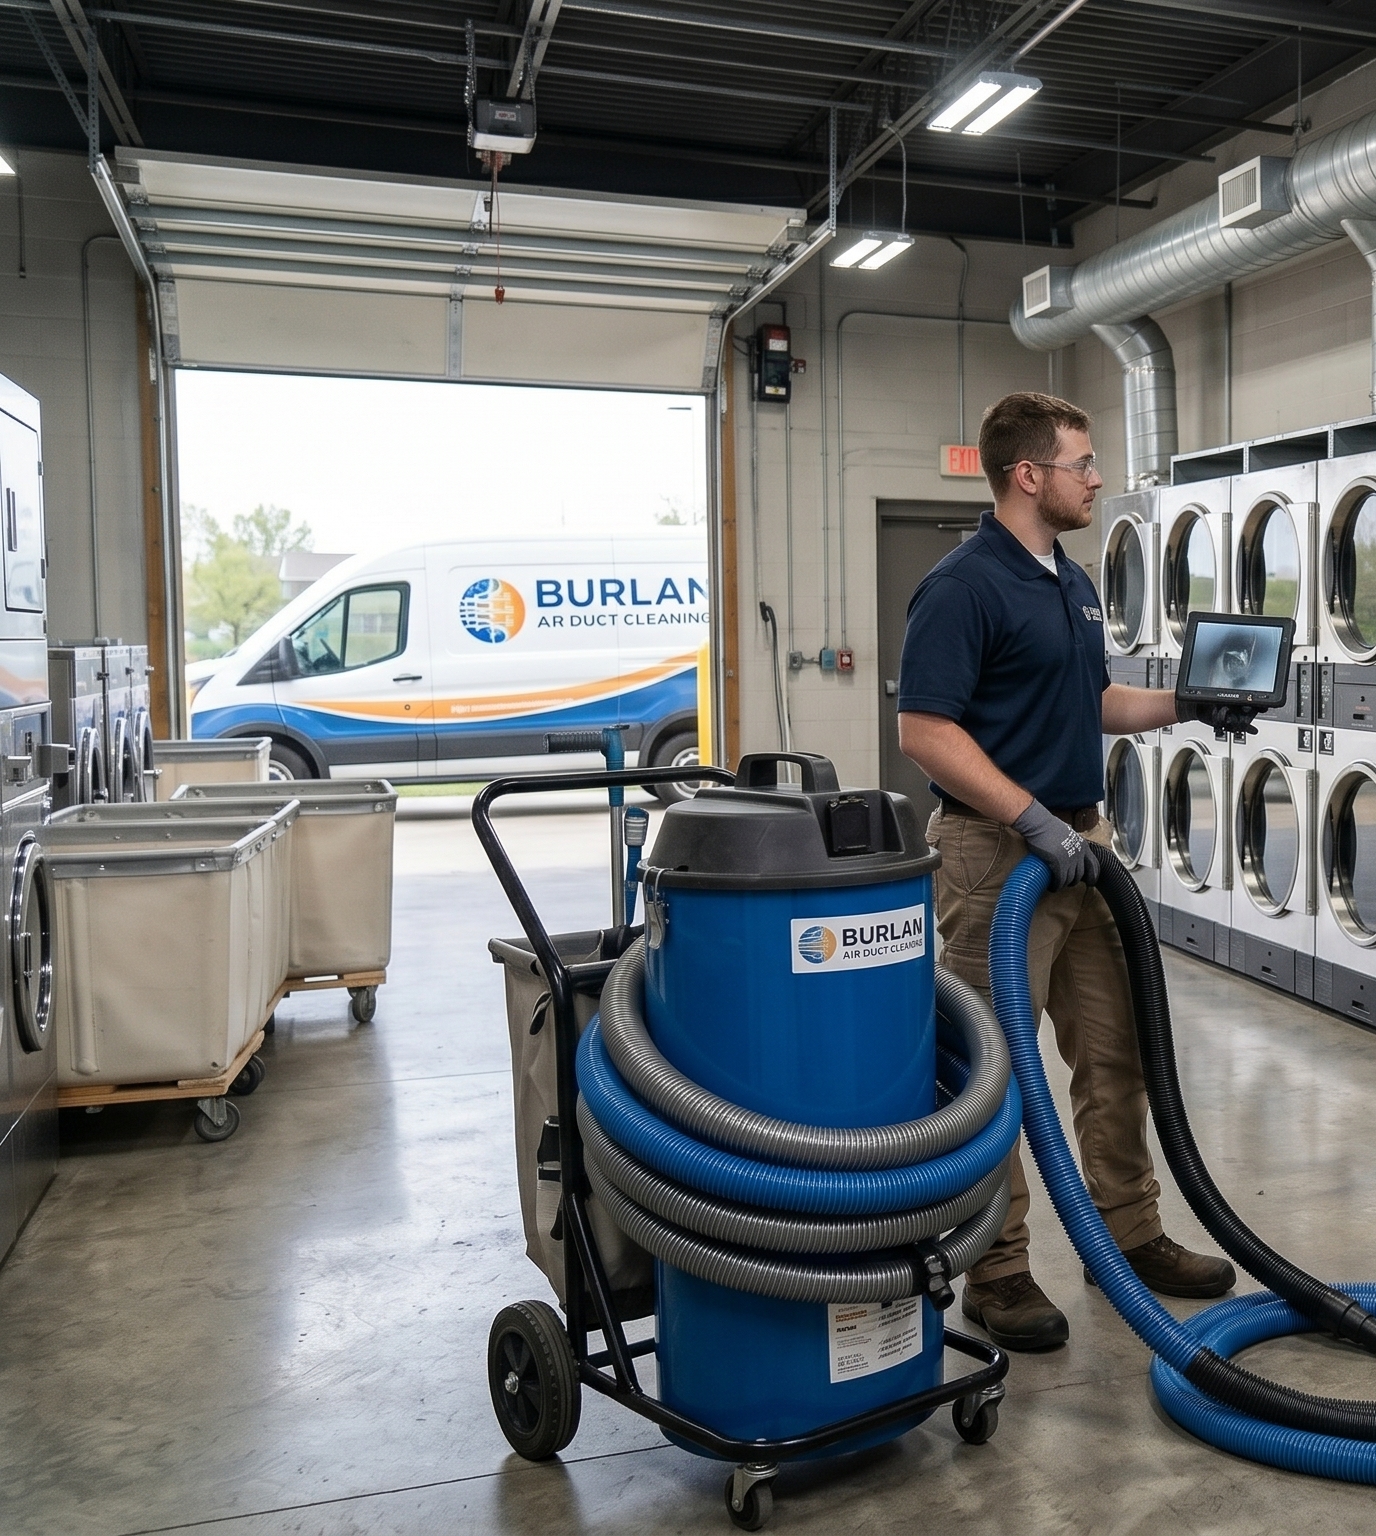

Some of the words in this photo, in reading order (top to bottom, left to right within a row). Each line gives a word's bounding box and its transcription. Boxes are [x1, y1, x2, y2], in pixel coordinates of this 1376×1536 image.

[949, 447, 979, 474] EXIT
[536, 577, 709, 608] BURLAN
[537, 615, 564, 628] AR
[570, 613, 618, 627] DUCT
[623, 612, 710, 626] CLEANING
[842, 916, 922, 947] BURLAN
[842, 950, 861, 960] AIR
[863, 946, 888, 958] DUCT
